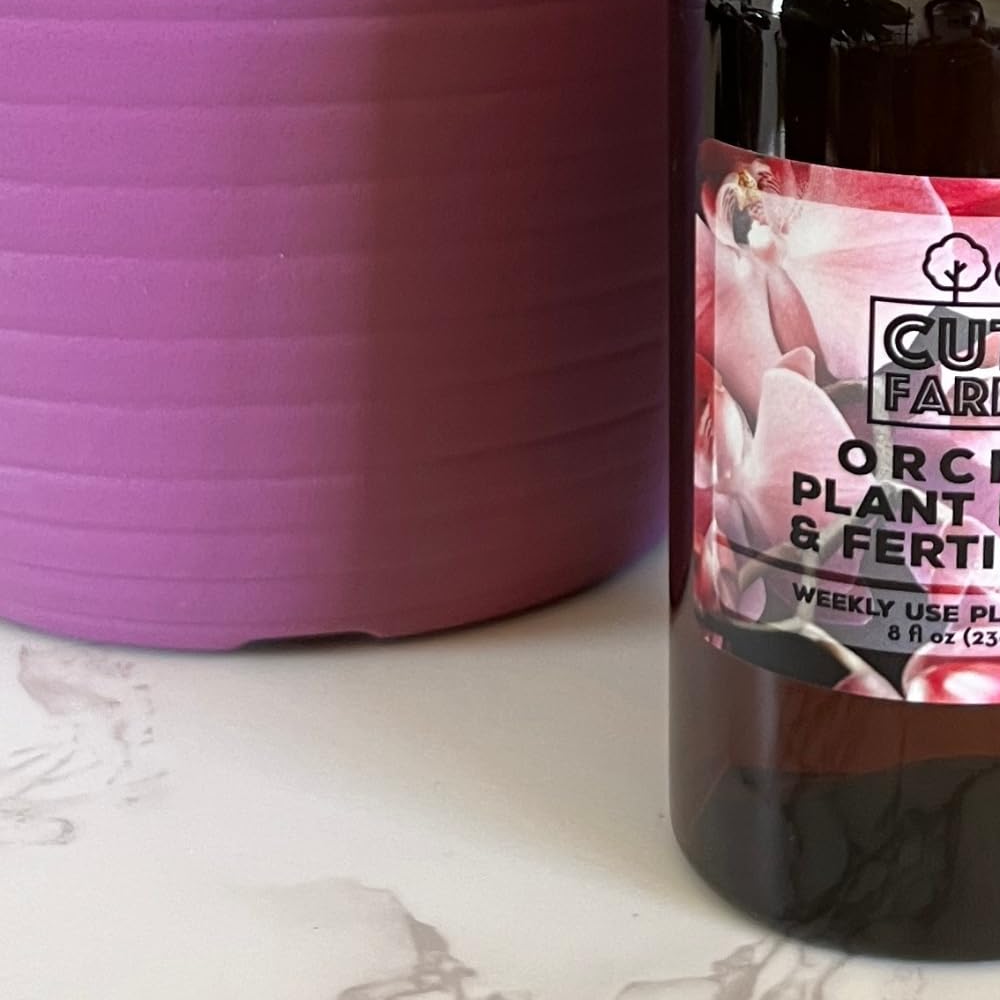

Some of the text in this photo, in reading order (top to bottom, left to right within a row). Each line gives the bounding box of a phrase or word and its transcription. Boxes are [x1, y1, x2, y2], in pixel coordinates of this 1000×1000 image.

[792, 471, 975, 526] PLANT
[790, 515, 820, 553] &
[792, 583, 895, 618] WEEKLY
[906, 602, 959, 622] USE
[887, 625, 901, 641] 8
[908, 625, 923, 643] fl
[930, 632, 956, 645] oz
